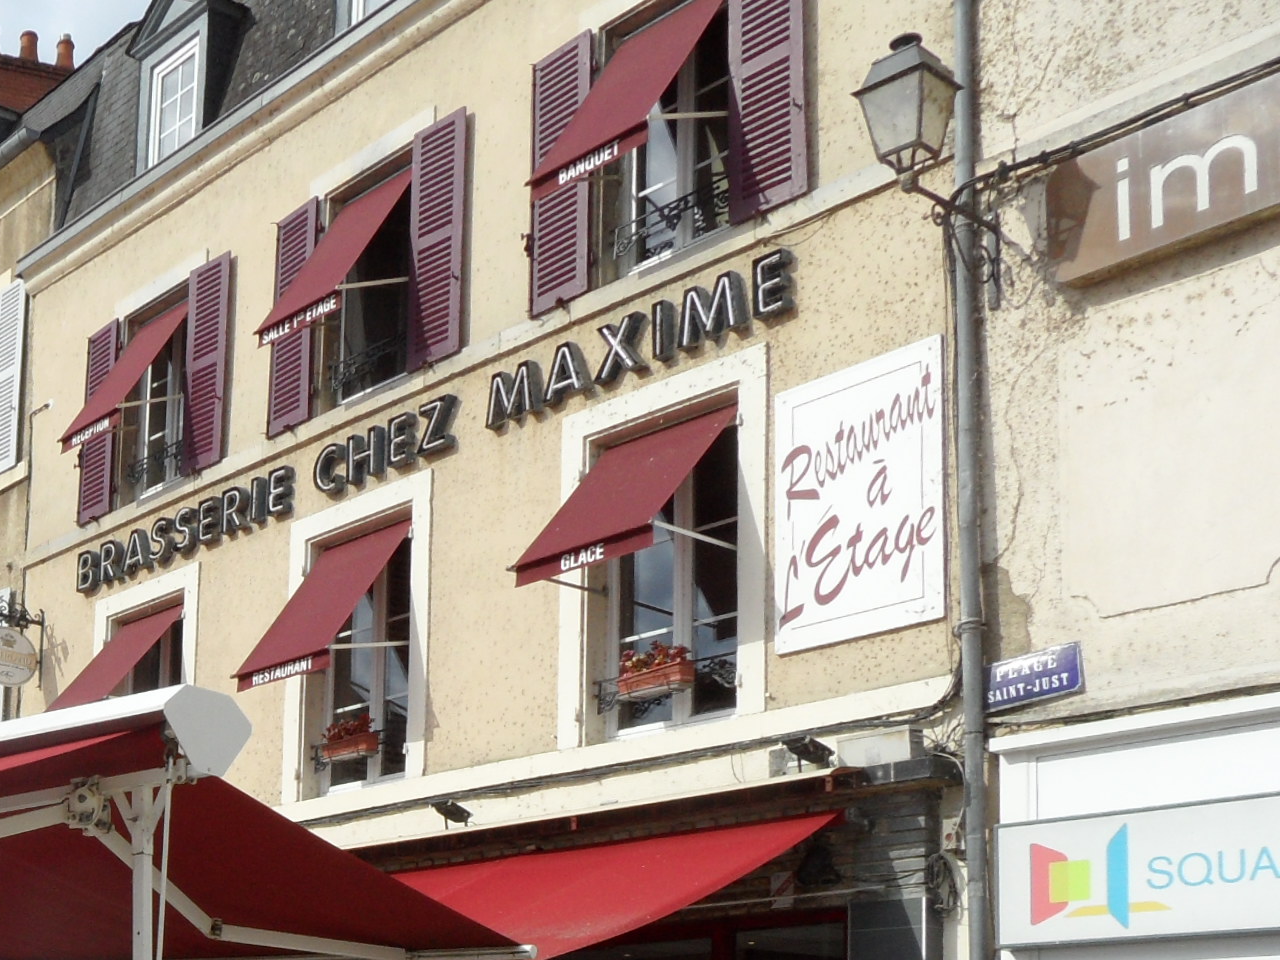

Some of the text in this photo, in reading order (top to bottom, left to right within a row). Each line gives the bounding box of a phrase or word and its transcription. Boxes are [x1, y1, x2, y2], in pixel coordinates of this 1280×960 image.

[558, 139, 619, 185] BANQUET
[262, 318, 290, 345] SALLE
[76, 248, 797, 593] BRASSERIE CHEZ MAXIME
[781, 363, 936, 521] Restaurant
[866, 458, 893, 508] à
[560, 542, 605, 571] GLACE
[252, 655, 314, 686] RESTAURANT
[995, 654, 1058, 682] PLACE
[987, 672, 1070, 704] SAINT-JUST
